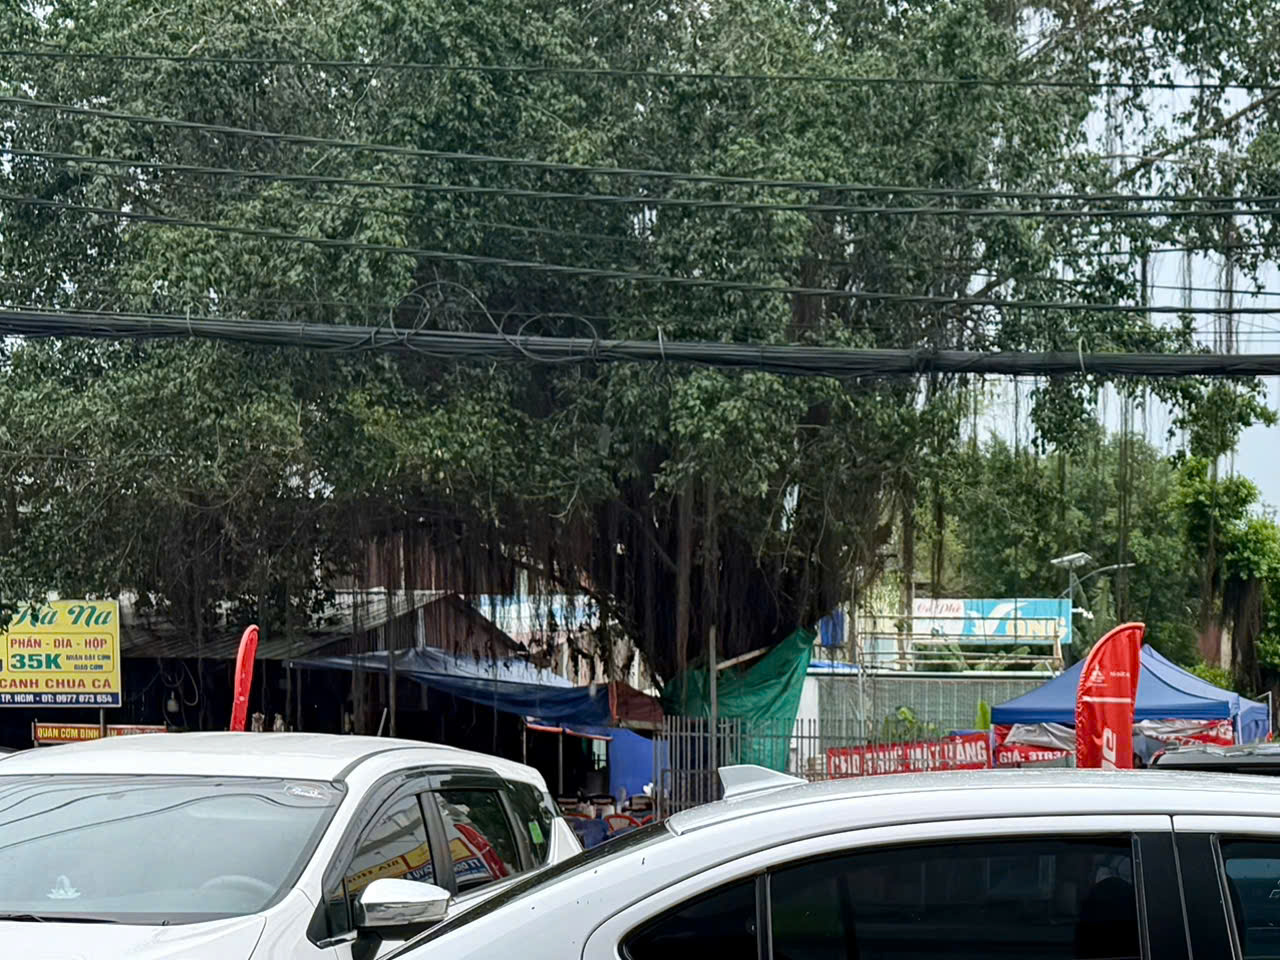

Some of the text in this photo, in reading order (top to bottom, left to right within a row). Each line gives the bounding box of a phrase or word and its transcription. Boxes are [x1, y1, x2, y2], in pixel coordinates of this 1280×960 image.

[10, 653, 62, 670] 35K
[0, 679, 39, 689] CANH
[45, 679, 86, 689] CHUA
[14, 694, 34, 703] HCM
